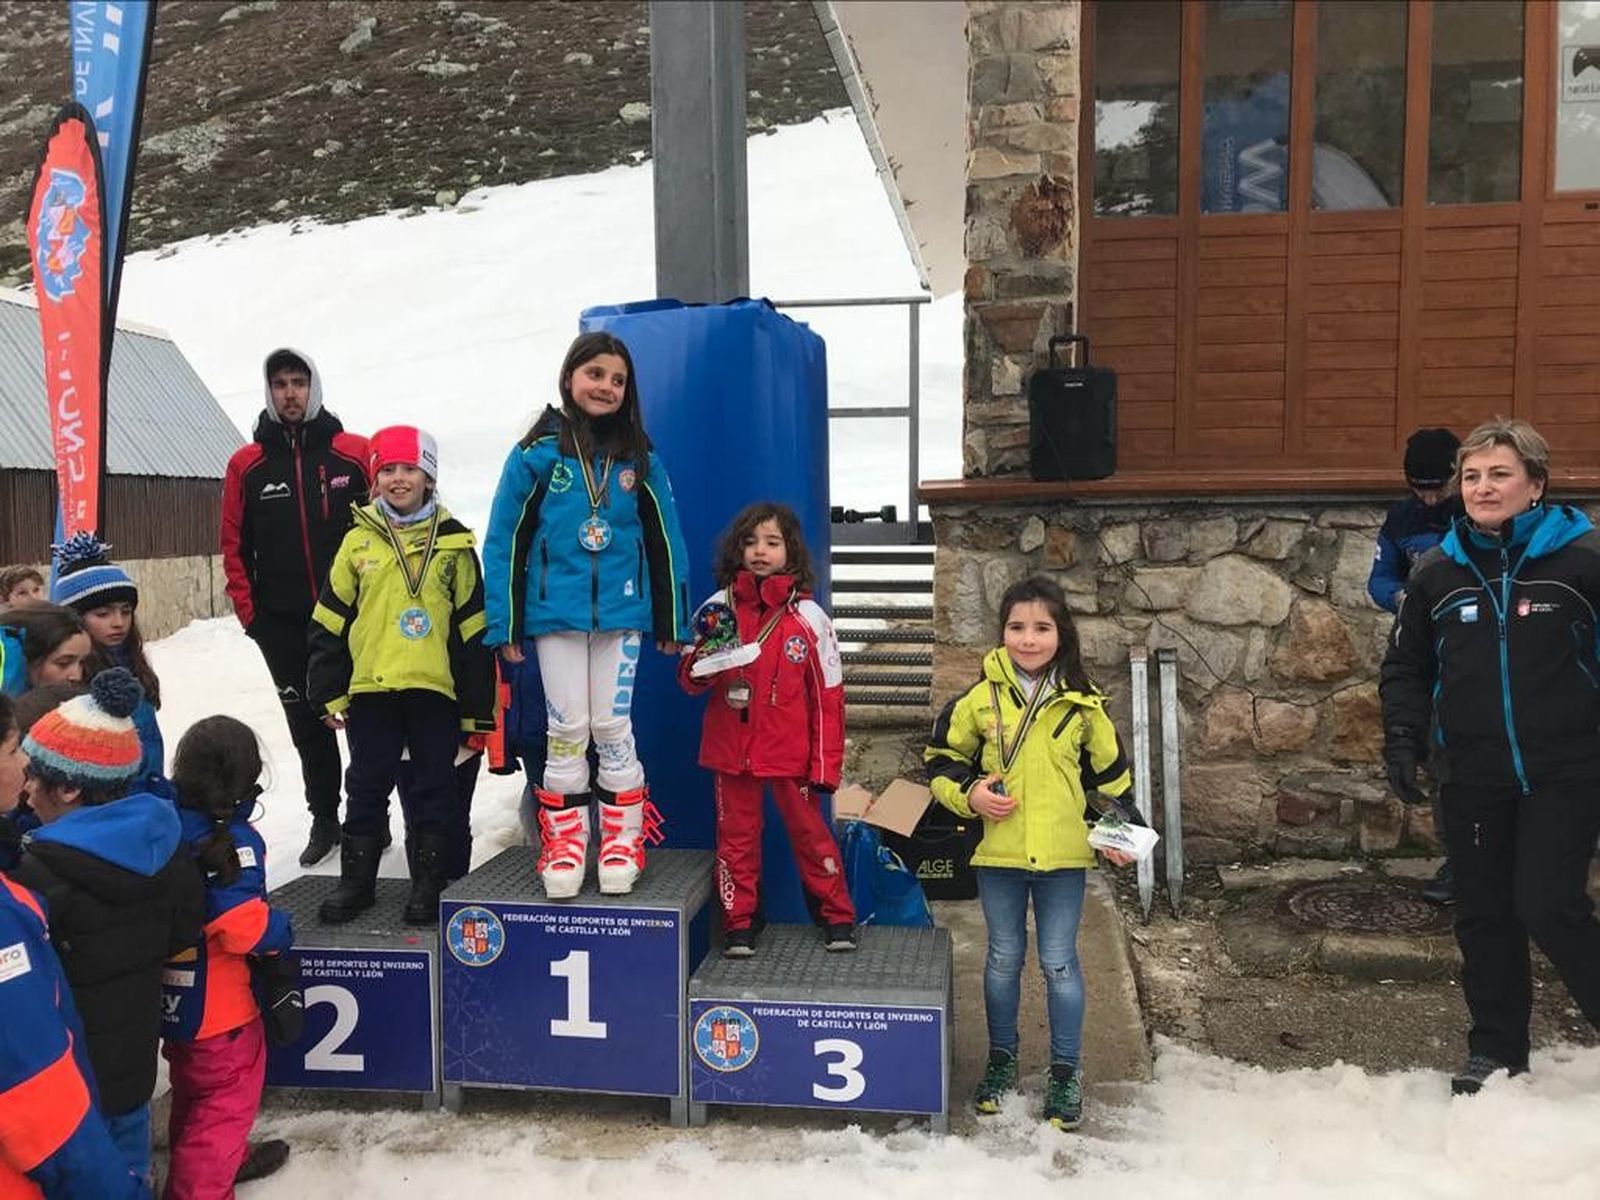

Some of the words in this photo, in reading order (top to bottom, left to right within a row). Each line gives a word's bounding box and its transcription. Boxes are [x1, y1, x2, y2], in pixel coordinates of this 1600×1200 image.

[917, 860, 954, 873] ALGE
[502, 914, 556, 924] FEDERACIÓN
[558, 916, 570, 924] DE
[571, 916, 616, 926] DEPORTES
[617, 918, 629, 926] DE
[630, 918, 674, 928] INVIERNO
[545, 926, 557, 934] DE
[558, 926, 599, 935] CASTILLA
[600, 927, 606, 935] Y
[608, 926, 631, 936] LEÓN
[314, 960, 324, 968] DE
[326, 960, 368, 969] DEPORTES
[370, 960, 381, 969] DE
[382, 961, 424, 970] INVIERNO
[302, 968, 313, 976] DE
[314, 969, 352, 978] CASTILLA
[354, 970, 361, 978] Y
[362, 970, 384, 978] LEÓN
[550, 950, 607, 1039] 1
[753, 1007, 809, 1018] FEDERACIÓN
[810, 1010, 822, 1018] DE
[824, 1010, 871, 1020] DEPORTES
[873, 1012, 885, 1021] DE
[887, 1012, 934, 1022] INVIERNO
[304, 984, 365, 1072] 2
[798, 1019, 810, 1028] DE
[811, 1020, 854, 1030] CASTILLA
[856, 1021, 863, 1030] Y
[864, 1020, 888, 1031] LEÓN
[812, 1038, 867, 1103] 3
